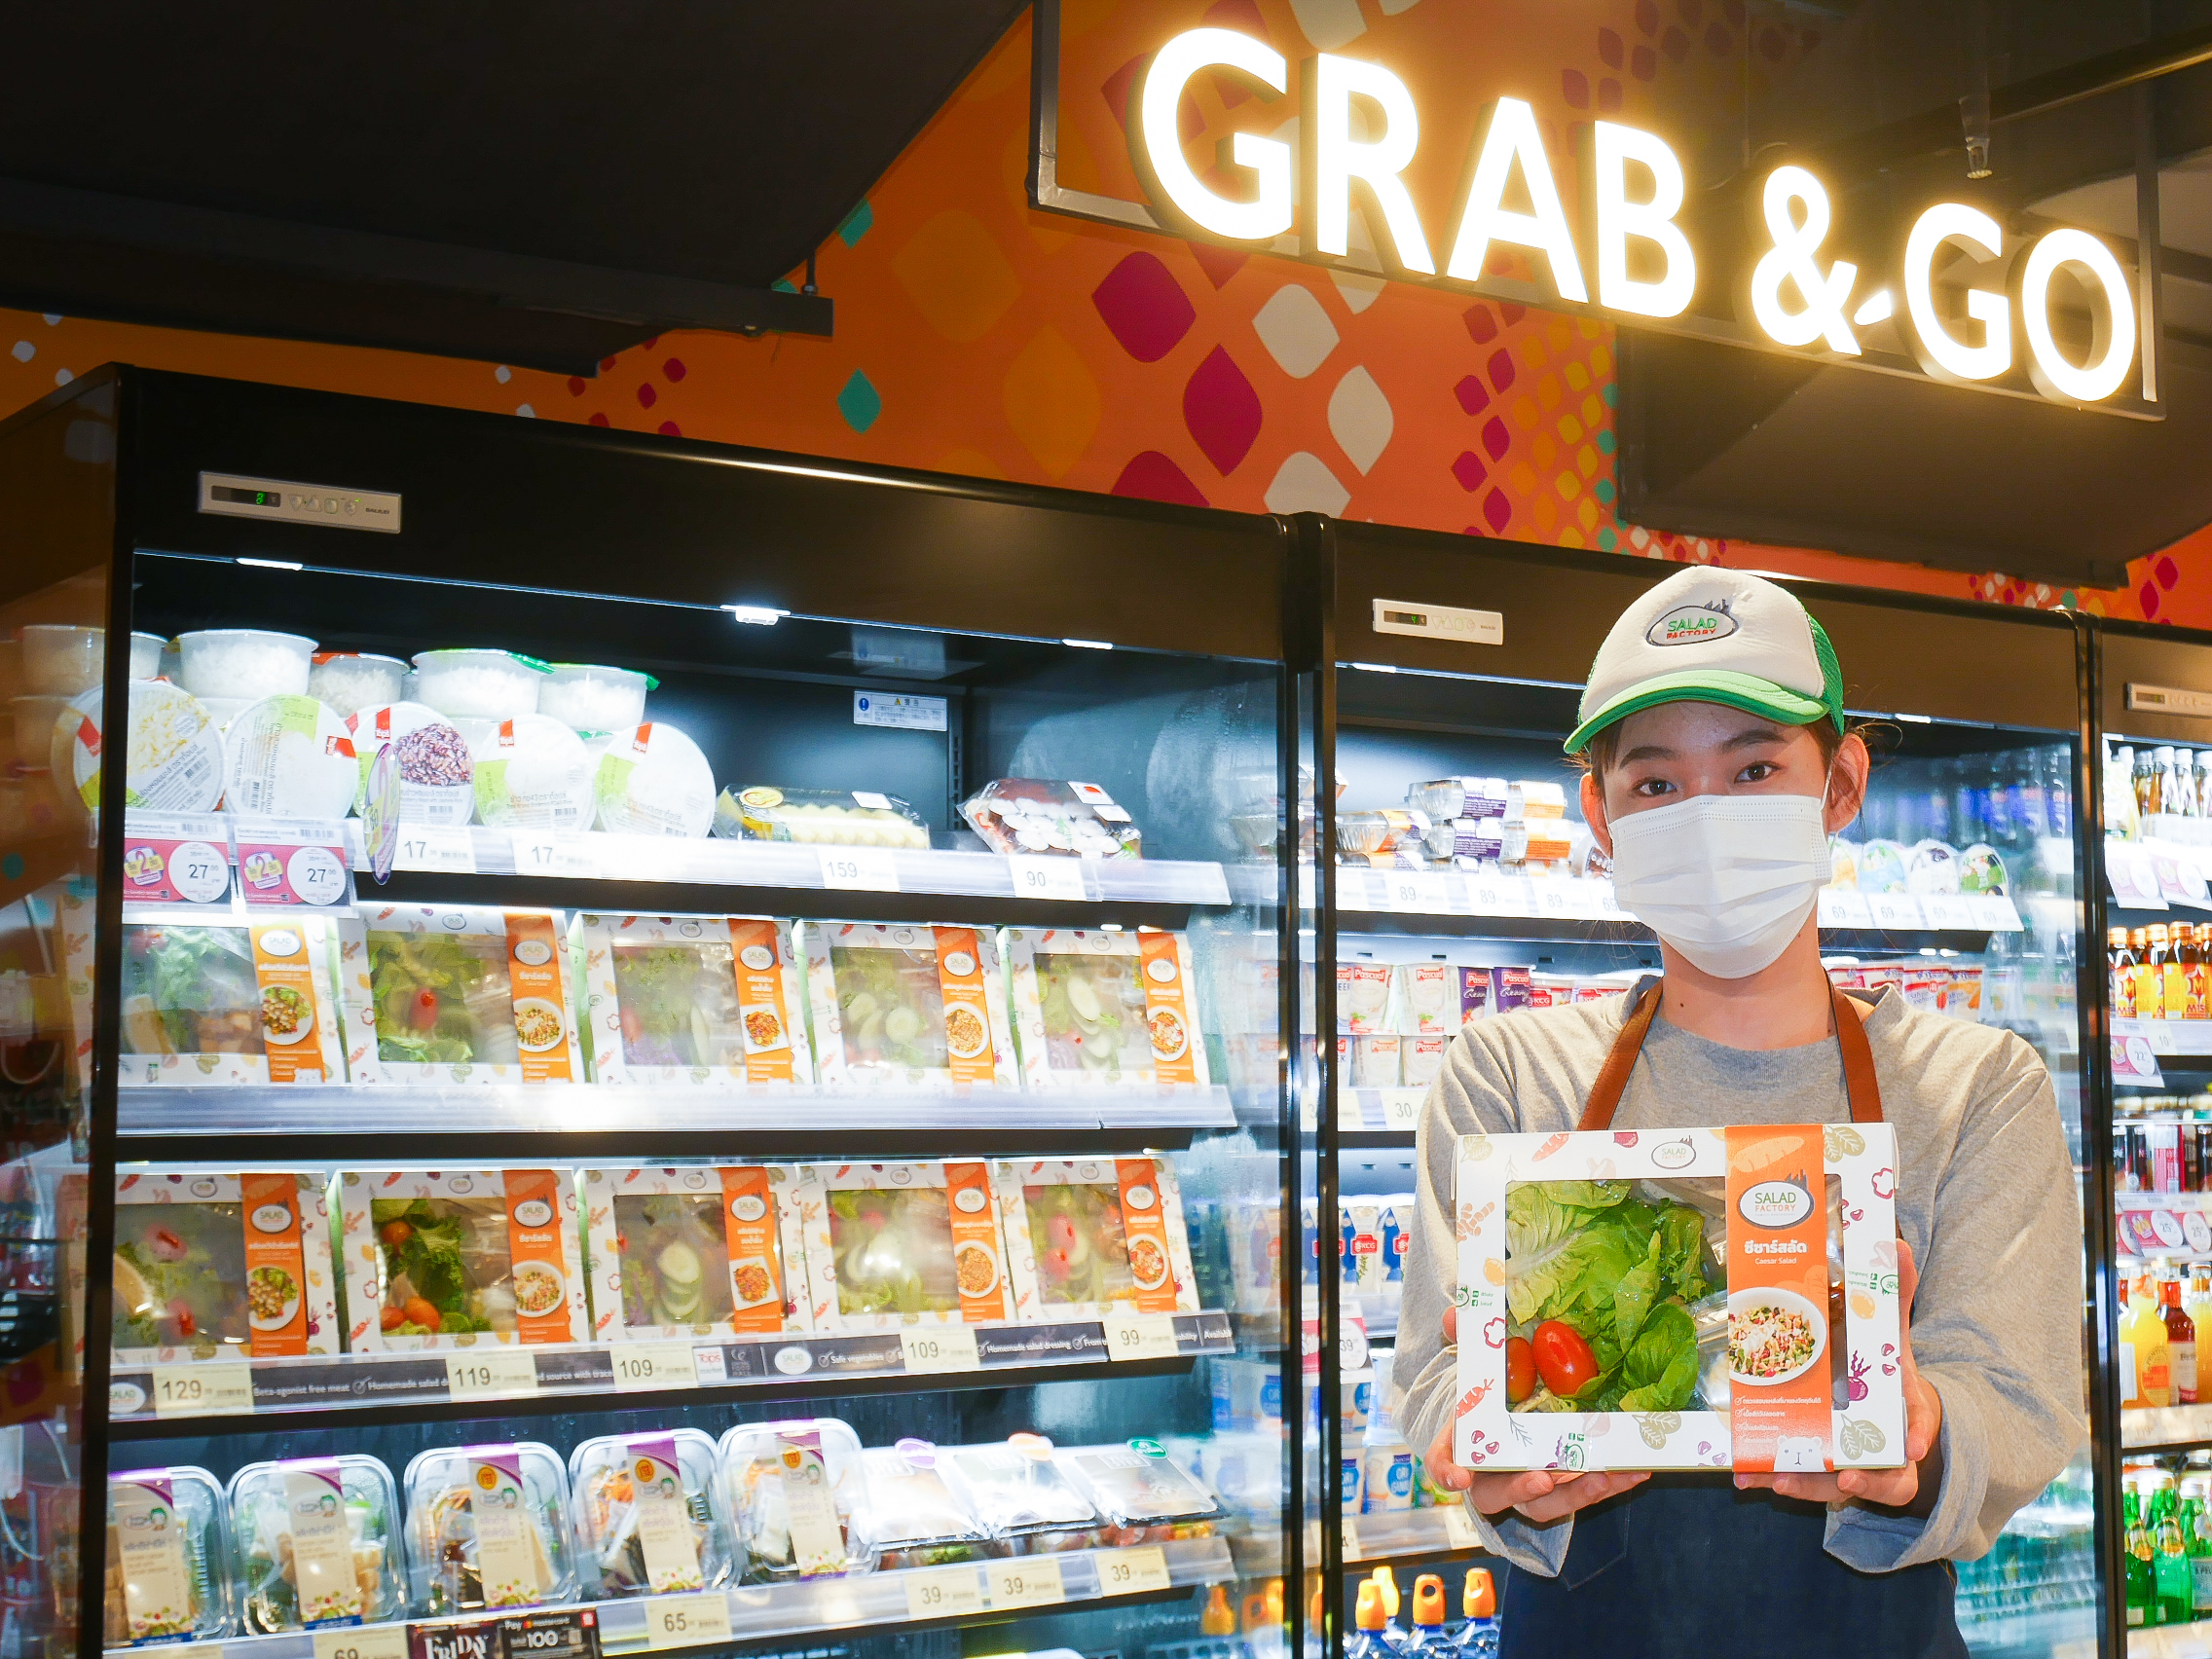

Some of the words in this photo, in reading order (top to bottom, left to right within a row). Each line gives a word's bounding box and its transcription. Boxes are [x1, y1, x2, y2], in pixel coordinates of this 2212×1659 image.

[1140, 26, 1697, 318] GRAB
[1751, 165, 1862, 356] &
[1901, 202, 2137, 403] GO
[1667, 617, 1717, 632] SALAD
[1666, 628, 1716, 640] FACTORY
[405, 840, 426, 859] 17
[532, 846, 553, 864] 17
[188, 864, 208, 880] 27
[307, 867, 327, 883] 27
[827, 862, 858, 878] 159
[1026, 870, 1047, 887] 90
[1399, 886, 1417, 902] 89
[1480, 890, 1496, 904] 89
[1546, 894, 1564, 908] 89
[1831, 906, 1847, 920] 69
[1880, 906, 1896, 920] 69
[1933, 906, 1947, 920] 69
[1982, 911, 1997, 924] 69
[522, 945, 543, 954] SALAD
[1354, 968, 1385, 980] Pascual
[1417, 969, 1444, 980] Pascual
[1417, 1042, 1442, 1052] Pascual
[2135, 1051, 2145, 1062] 22
[1395, 1102, 1412, 1119] 30
[1754, 1192, 1797, 1205] SALAD
[522, 1206, 544, 1215] SALAD
[1754, 1204, 1797, 1213] FACTORY
[2160, 1223, 2171, 1234] 25
[1744, 1238, 1808, 1255] ซีซาร์สลัด
[1084, 1338, 1099, 1347] From
[1121, 1329, 1140, 1346] 99
[908, 1341, 939, 1359] 109
[987, 1342, 1026, 1353] Homemade
[1027, 1341, 1045, 1350] salad
[1045, 1339, 1072, 1350] dressing
[698, 1353, 721, 1365] Tops
[782, 1353, 804, 1362] SALAD
[830, 1354, 846, 1364] Safe
[847, 1353, 884, 1365] vegetables
[619, 1359, 653, 1379] 109
[368, 1380, 417, 1390] Homemade
[418, 1378, 440, 1388] salad
[455, 1367, 492, 1387] 119
[163, 1380, 202, 1401] 129
[309, 1382, 326, 1393] free
[327, 1383, 350, 1393] meat
[1110, 1564, 1131, 1583] 39
[1003, 1576, 1024, 1596] 39
[921, 1585, 942, 1604] 39
[504, 1619, 523, 1632] Pay
[663, 1612, 687, 1633] 65
[527, 1630, 559, 1648] 100
